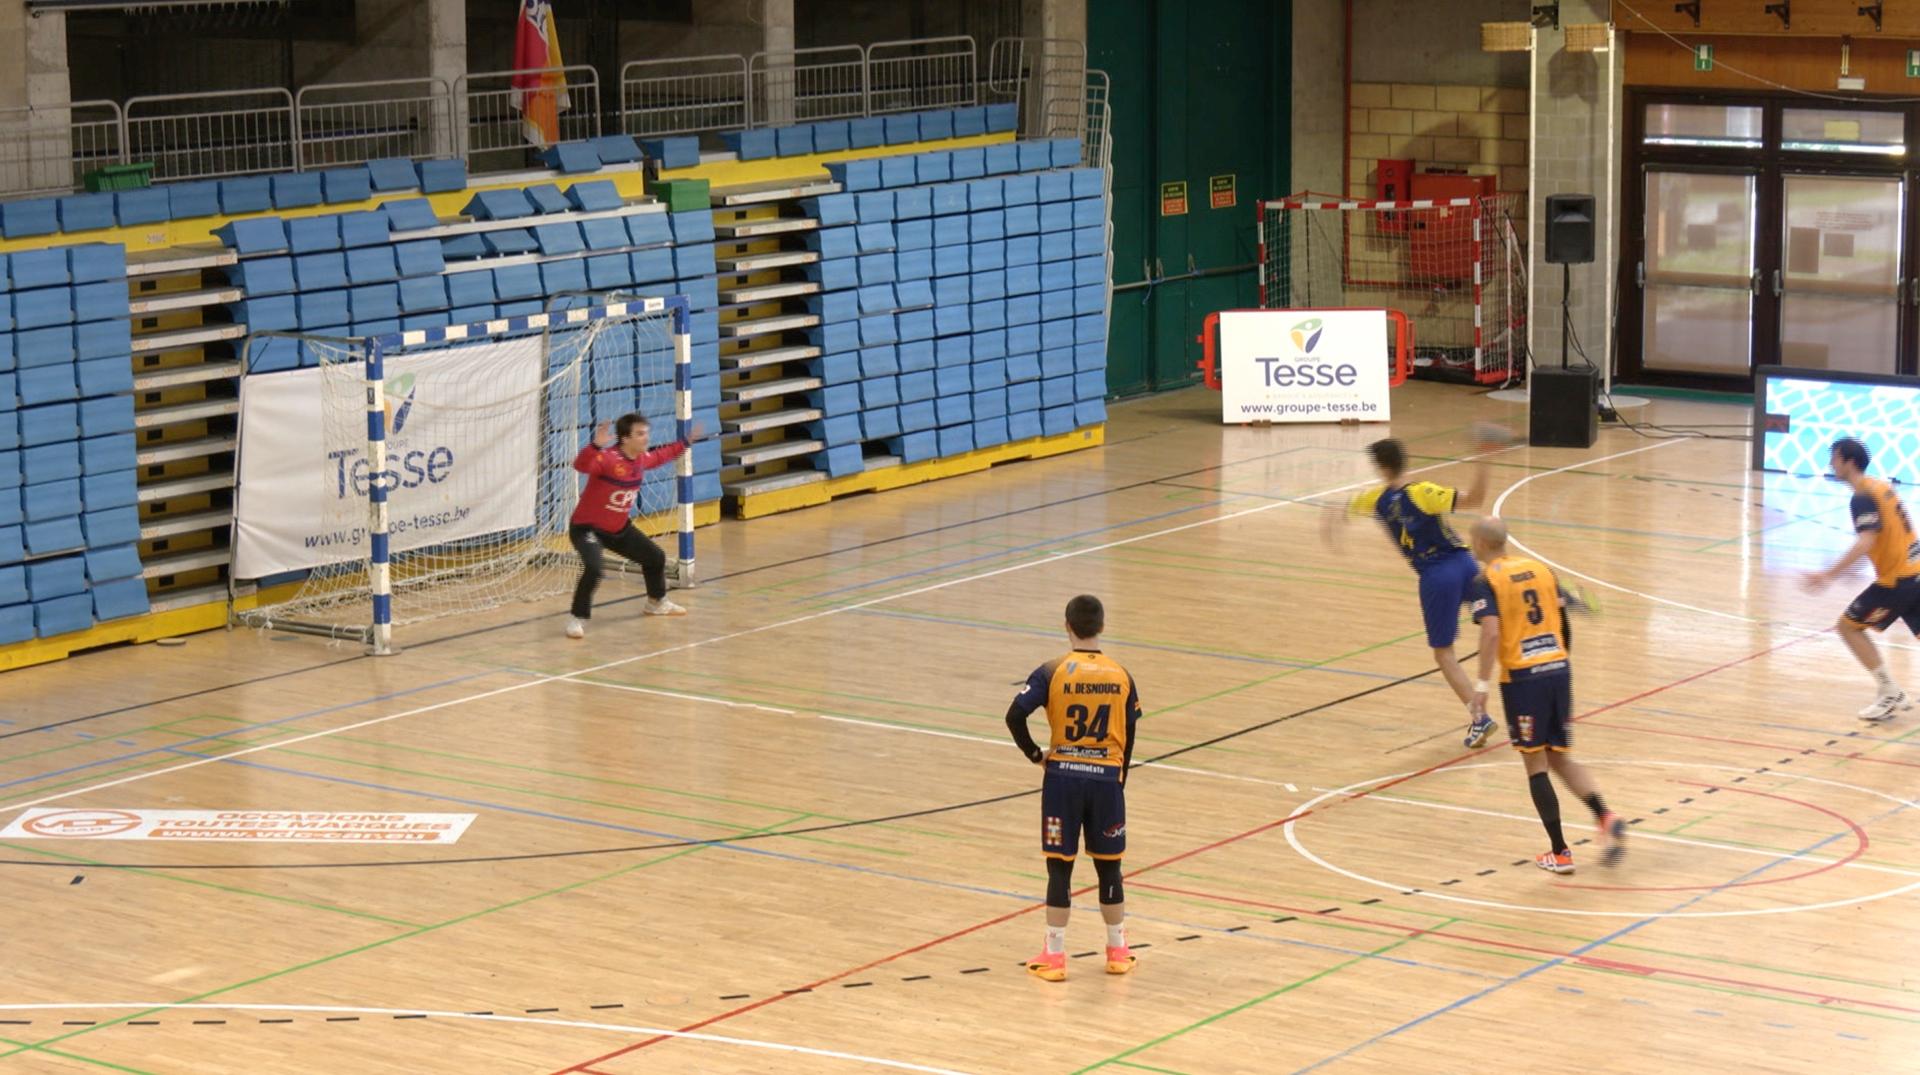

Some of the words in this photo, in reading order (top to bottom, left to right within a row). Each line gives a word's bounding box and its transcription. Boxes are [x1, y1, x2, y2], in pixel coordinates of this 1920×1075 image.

[1255, 357, 1358, 387] Tesse
[1241, 401, 1377, 415] www.groupe-tesse.be
[304, 506, 470, 548] www.grpe-tesse.be
[1522, 588, 1545, 625] 3
[1065, 704, 1111, 742] 34
[157, 820, 279, 828] TOUTES
[294, 822, 452, 830] MARQUES
[216, 813, 406, 821] OCCASIONS
